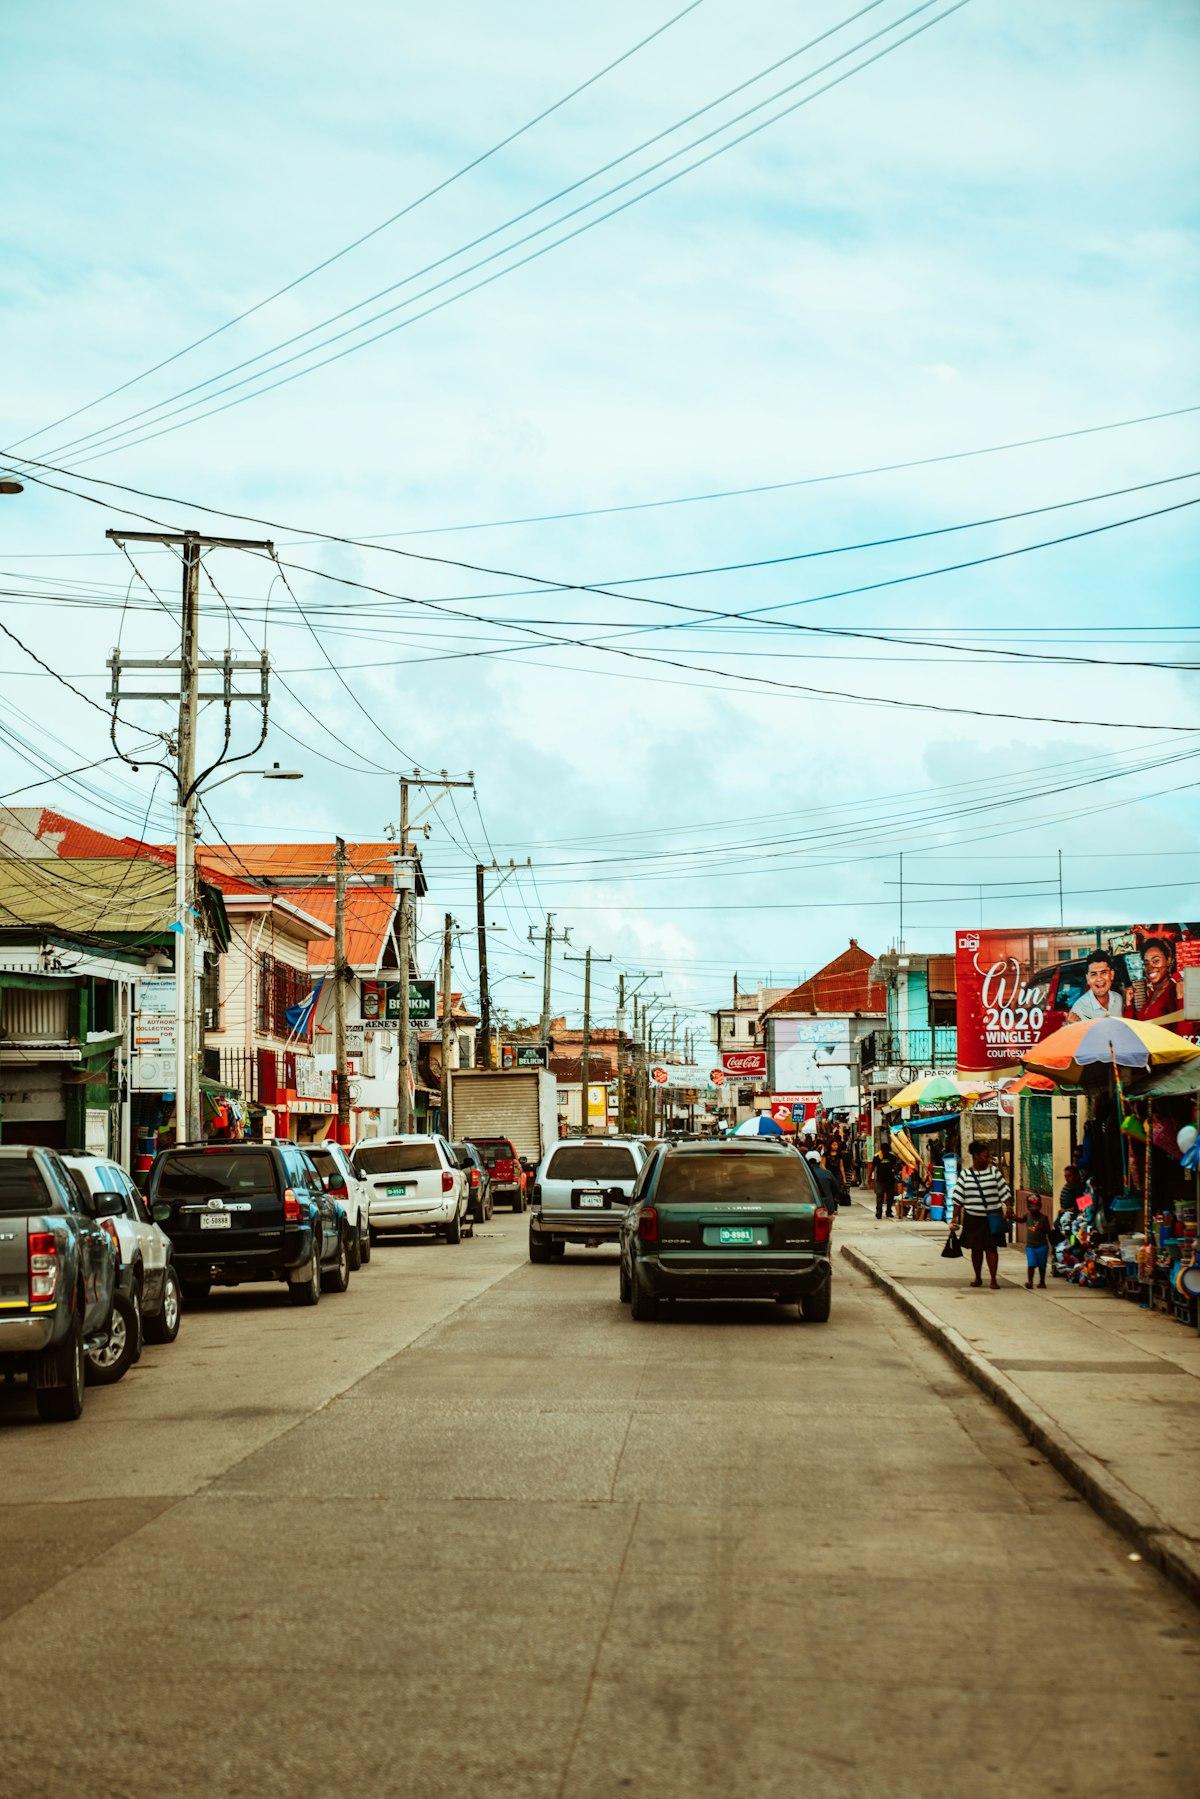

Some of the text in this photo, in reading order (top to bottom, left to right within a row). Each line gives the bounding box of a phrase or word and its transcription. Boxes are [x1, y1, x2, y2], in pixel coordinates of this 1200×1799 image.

[973, 953, 1046, 1009] Win
[388, 999, 431, 1010] BEIKIN
[985, 1008, 1044, 1030] 2020
[986, 1031, 1041, 1043] WINGLE 7
